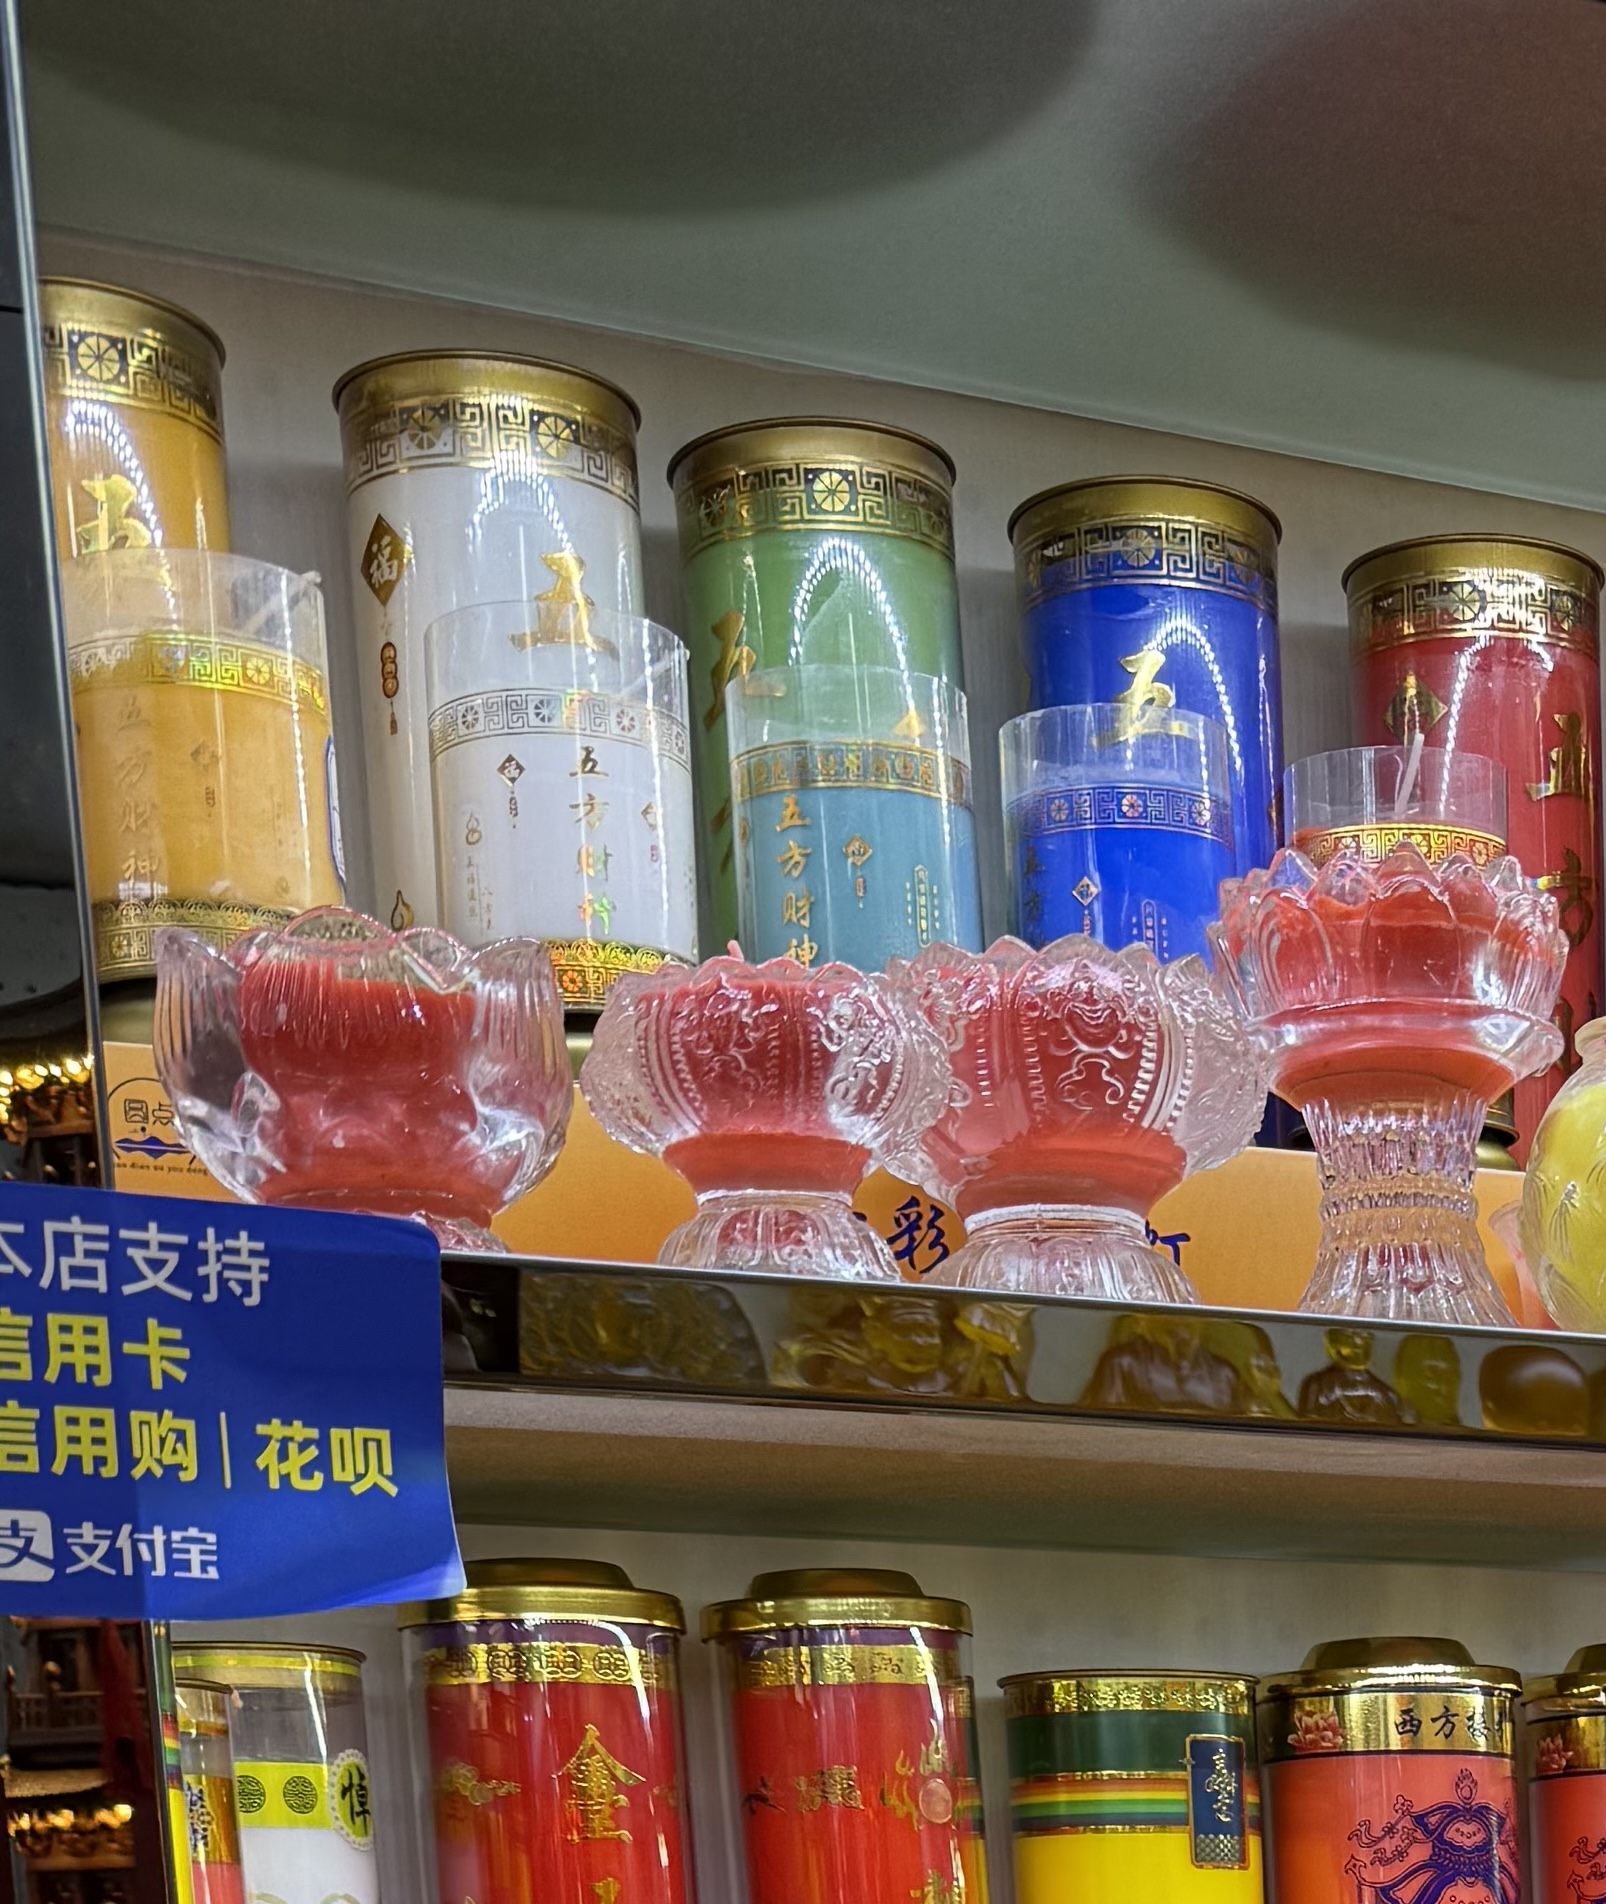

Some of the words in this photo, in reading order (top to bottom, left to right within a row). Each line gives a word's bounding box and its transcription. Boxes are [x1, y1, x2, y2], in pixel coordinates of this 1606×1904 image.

[509, 549, 622, 660] 五
[255, 1417, 399, 1497] 花呗
[62, 1520, 220, 1580] 支付宝
